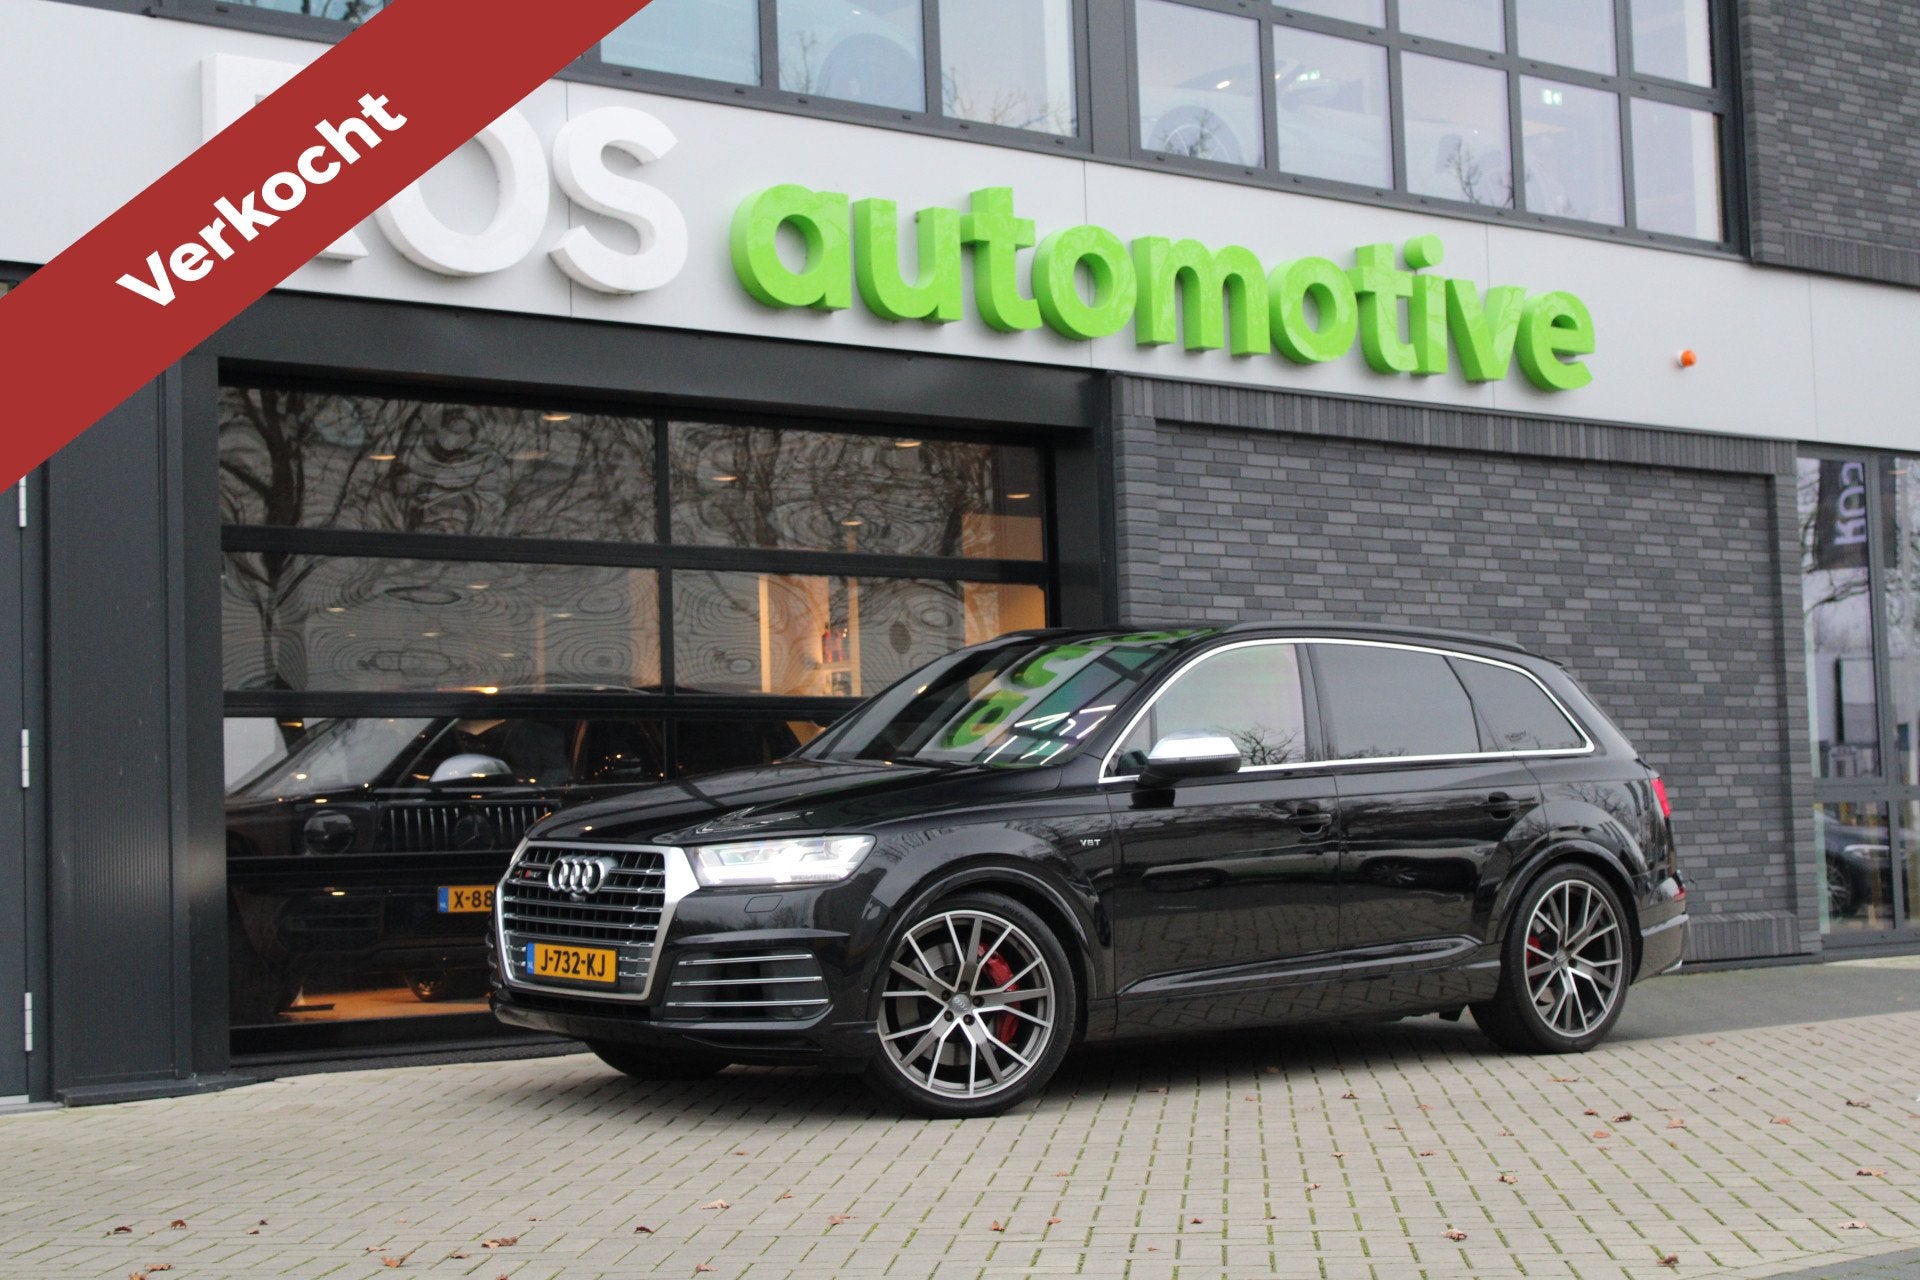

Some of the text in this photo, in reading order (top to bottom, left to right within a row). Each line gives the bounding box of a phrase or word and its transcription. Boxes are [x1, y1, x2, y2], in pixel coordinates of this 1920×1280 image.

[201, 52, 1596, 391] OS automotive
[540, 948, 606, 978] J-732-KJ
